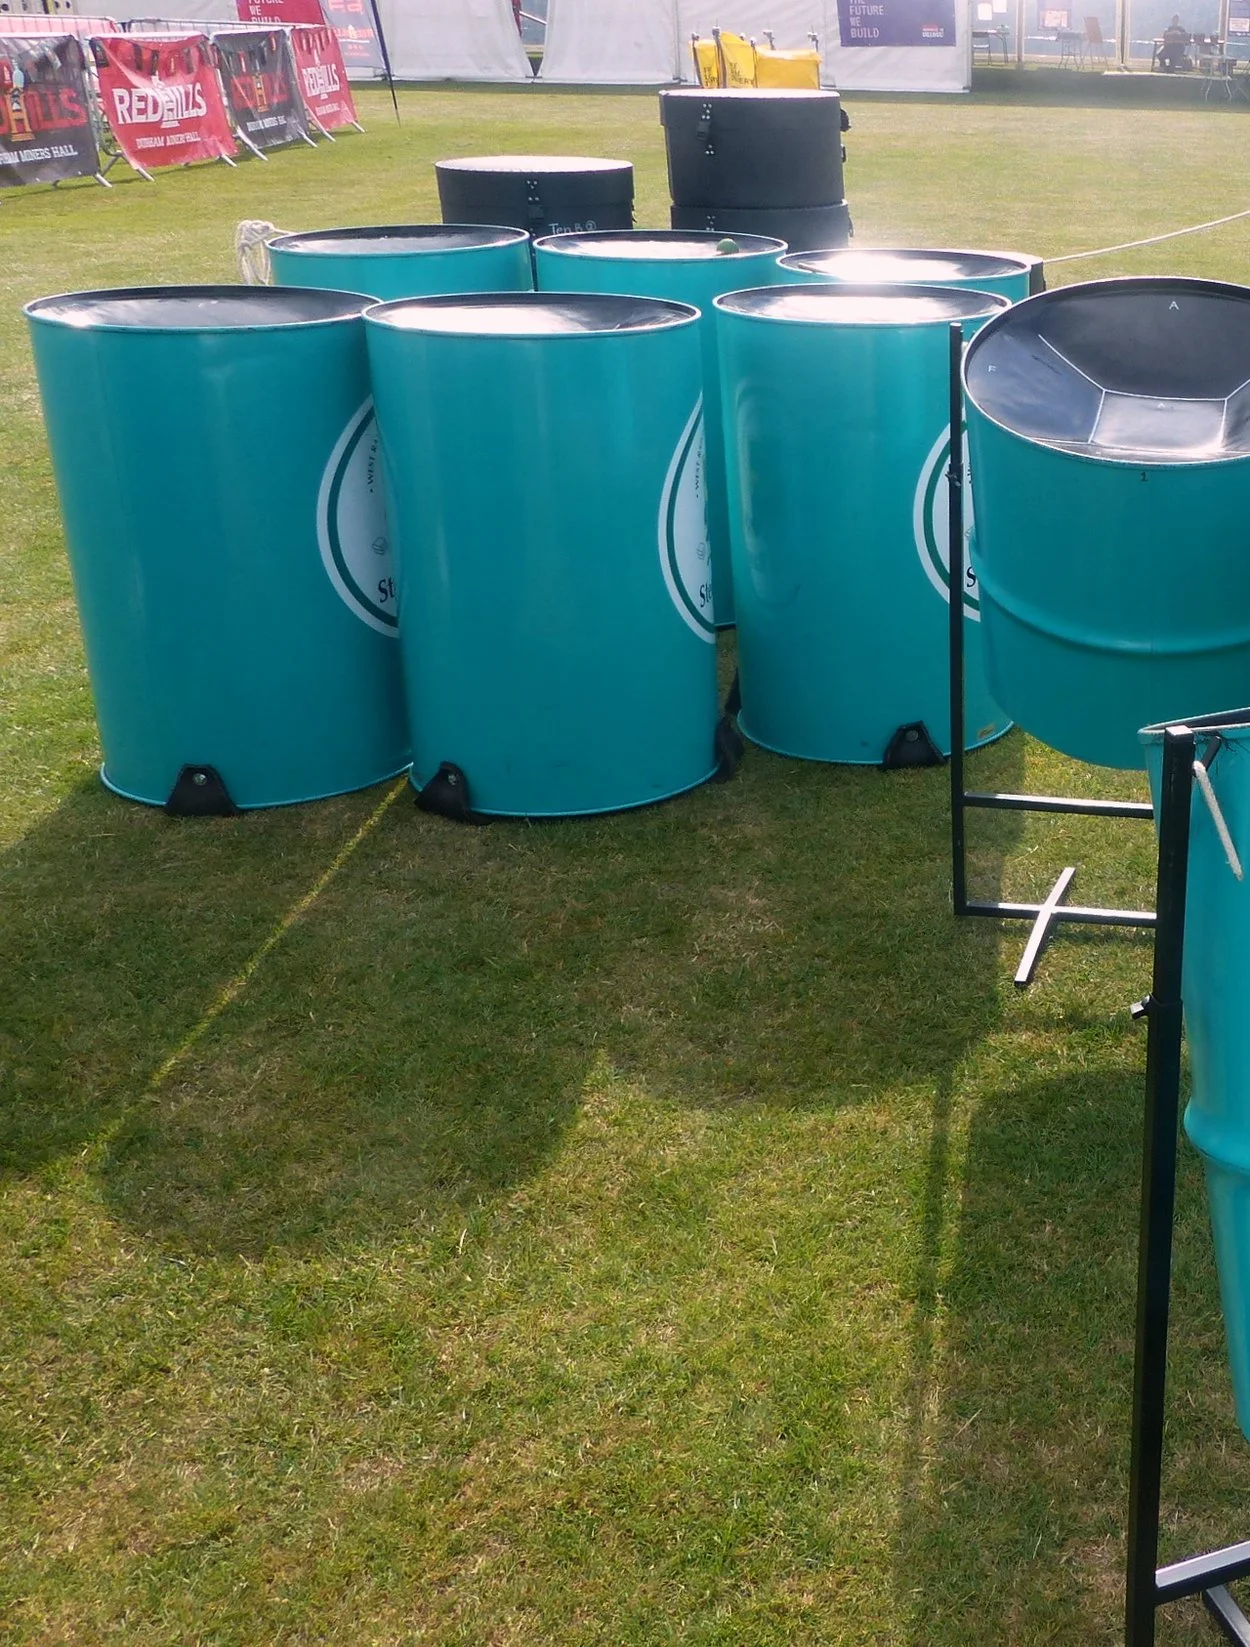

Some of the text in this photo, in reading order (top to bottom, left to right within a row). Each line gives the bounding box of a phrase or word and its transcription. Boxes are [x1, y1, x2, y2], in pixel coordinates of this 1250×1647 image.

[249, 5, 262, 15] WE
[849, 5, 884, 15] FUTURE
[850, 16, 861, 26] WE
[851, 27, 880, 38] BUILD
[112, 82, 207, 125] REDHILLS
[51, 144, 78, 158] HALL
[1168, 300, 1180, 310] A
[988, 365, 997, 373] F
